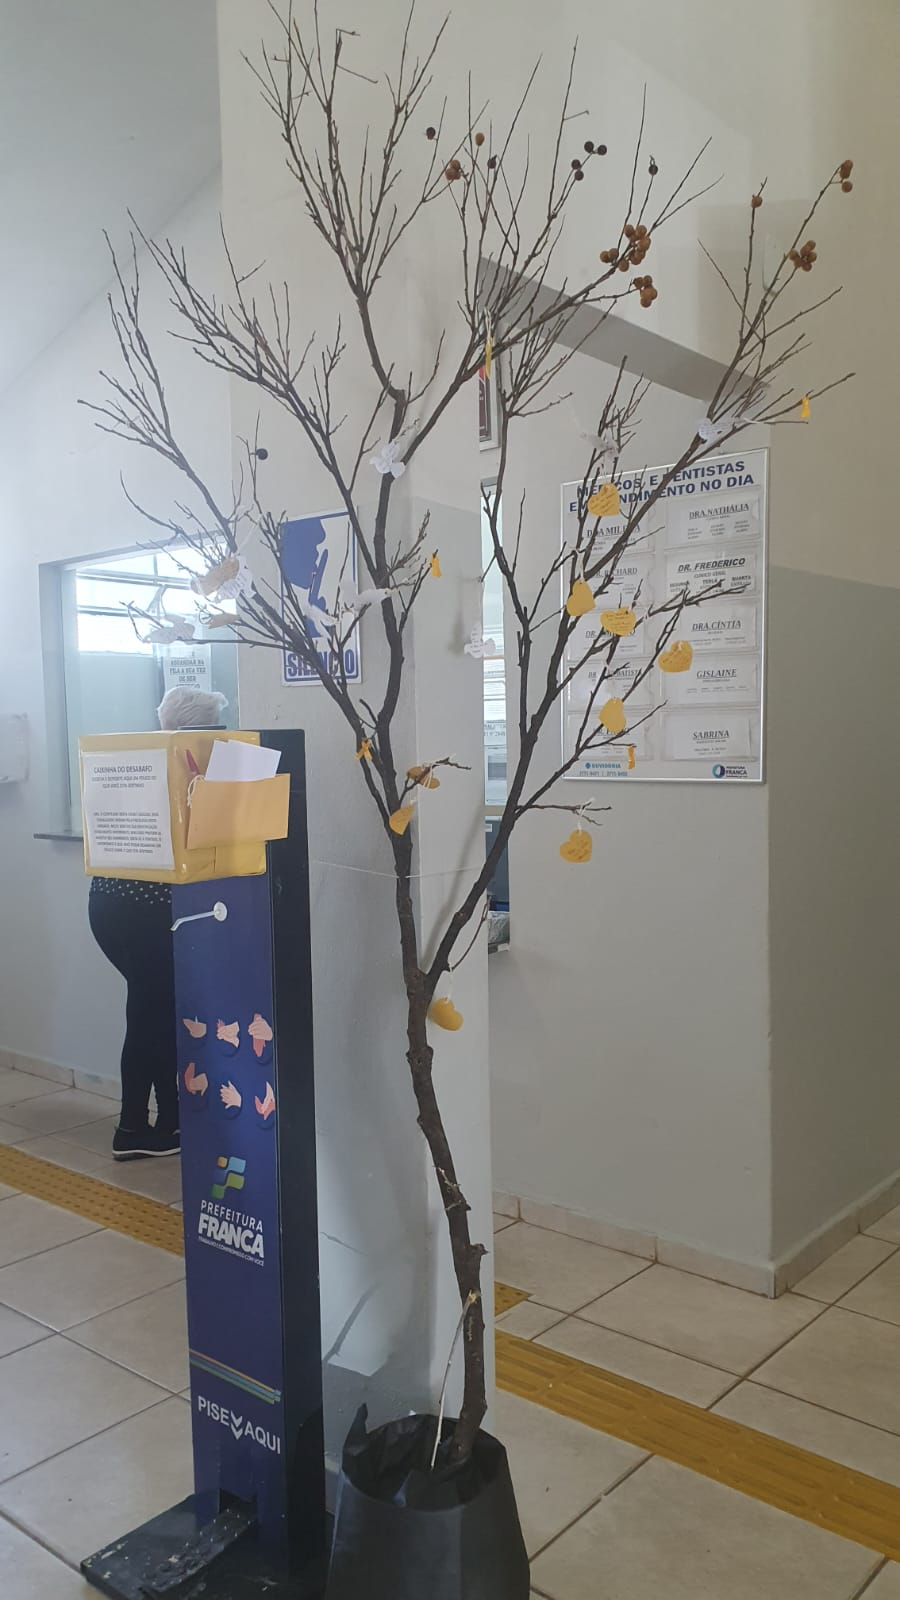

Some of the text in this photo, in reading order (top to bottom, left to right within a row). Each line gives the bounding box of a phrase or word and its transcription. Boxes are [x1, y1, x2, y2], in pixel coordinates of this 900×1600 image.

[649, 474, 659, 487] E
[664, 460, 745, 484] ENTISTAS
[700, 478, 722, 492] NO
[726, 473, 754, 488] DIA
[694, 557, 746, 571] FREDERICO
[692, 730, 729, 740] SABRINA
[201, 1199, 264, 1233] PREFEITURA
[198, 1212, 265, 1259] FRANCA
[198, 1395, 281, 1455] PISE AQUI
